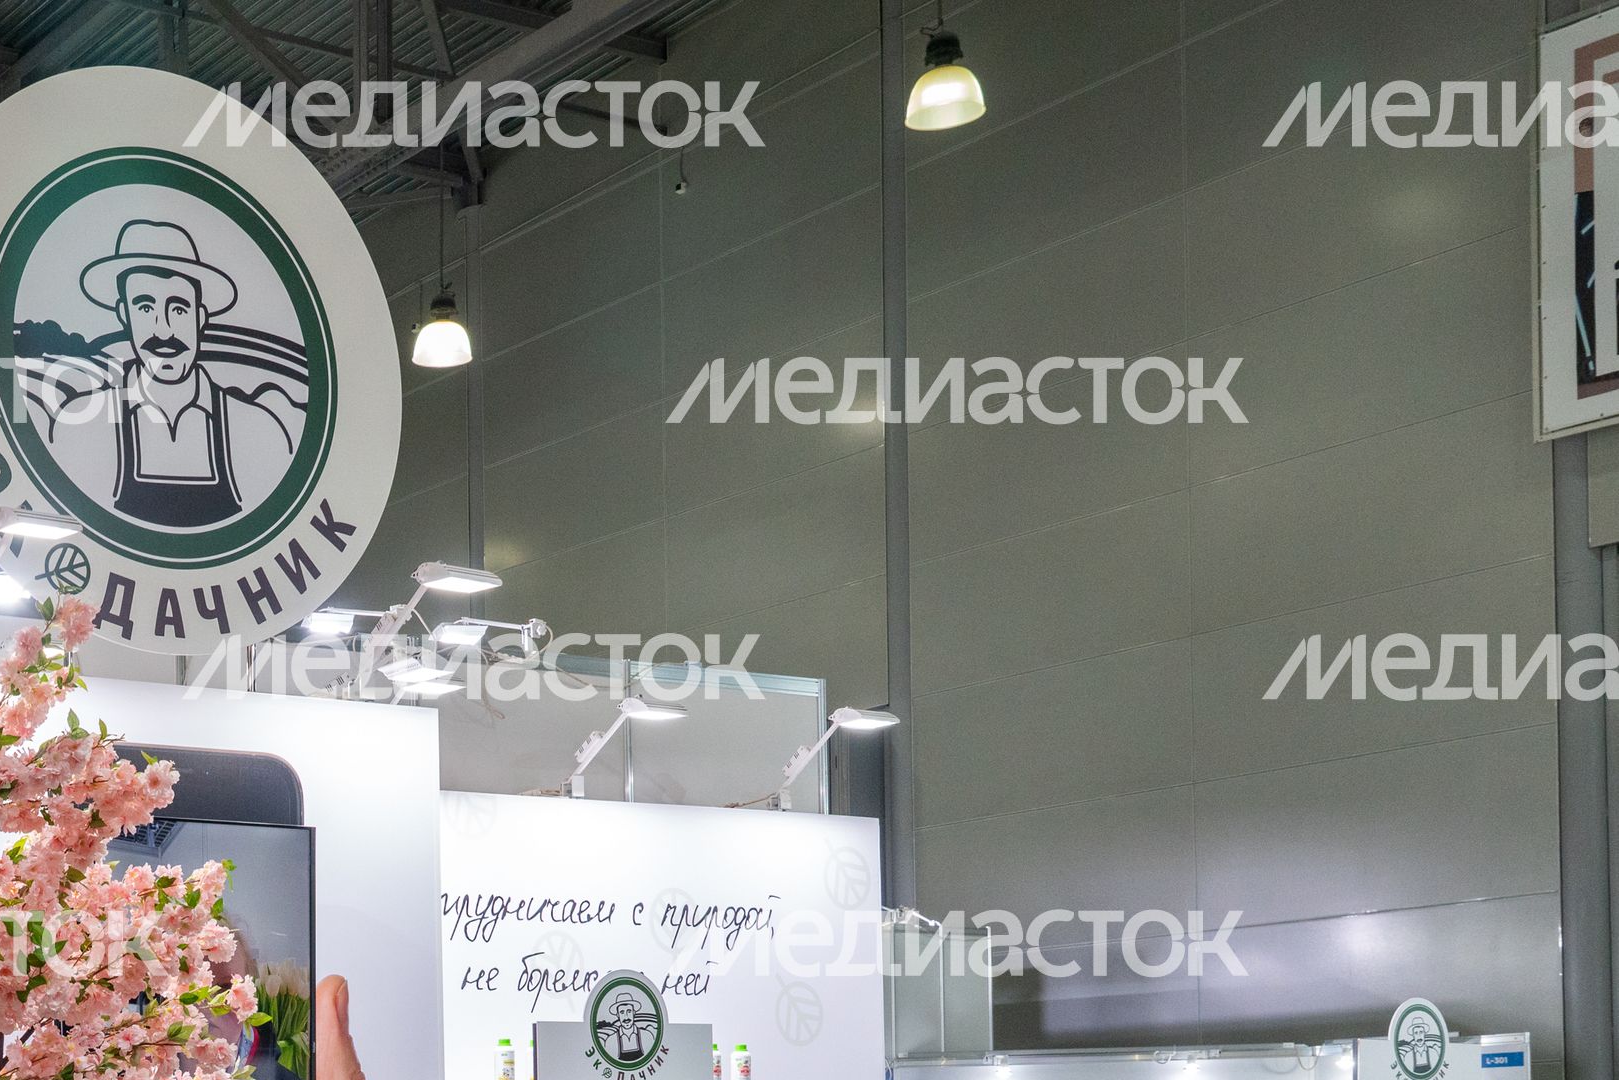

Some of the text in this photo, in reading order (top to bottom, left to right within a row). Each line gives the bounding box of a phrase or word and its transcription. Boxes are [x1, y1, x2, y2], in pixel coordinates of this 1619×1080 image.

[632, 902, 645, 926] с
[461, 966, 500, 992] не
[661, 960, 719, 996] ней
